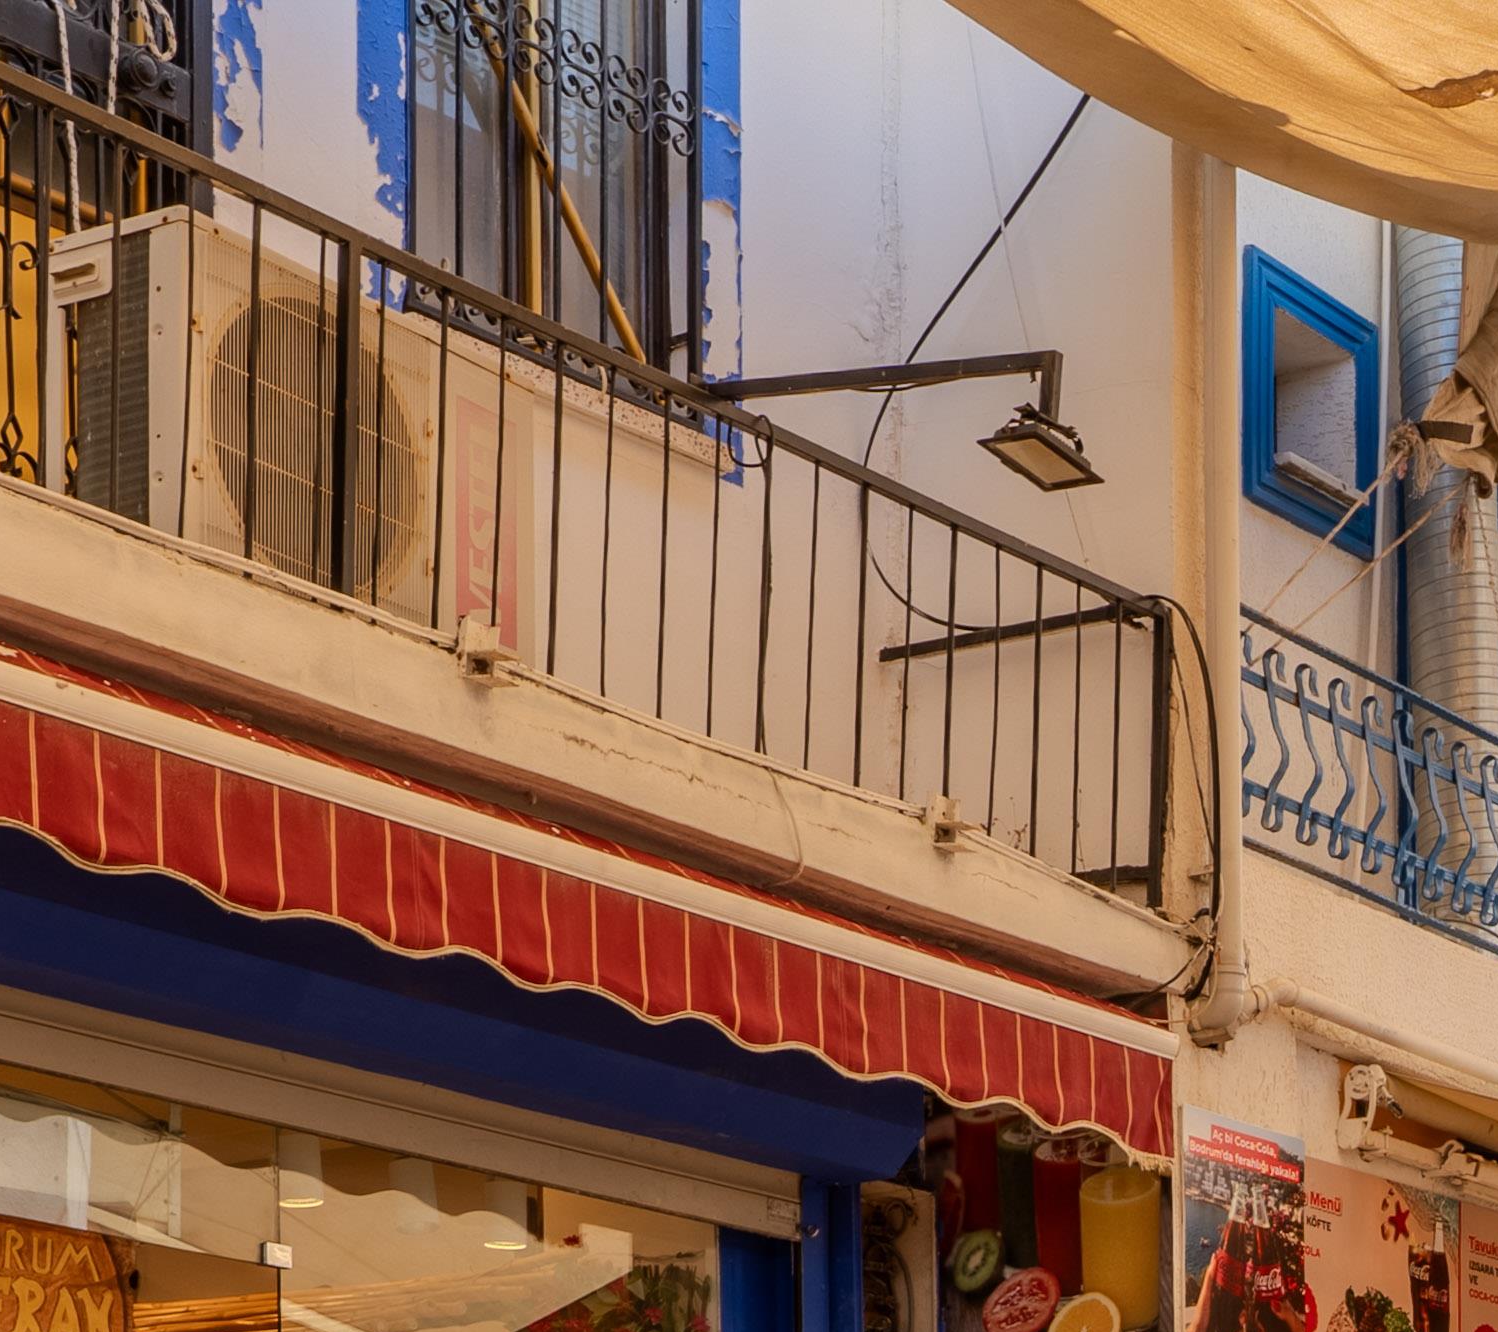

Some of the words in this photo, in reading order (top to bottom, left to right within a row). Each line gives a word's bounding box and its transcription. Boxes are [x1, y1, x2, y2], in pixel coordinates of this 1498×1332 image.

[1212, 1129, 1223, 1143] Aç
[1225, 1132, 1234, 1143] bi
[1189, 1140, 1234, 1162] Bodrum'da
[1270, 1162, 1299, 1181] yakala!
[1306, 1215, 1333, 1232] KÖFTE
[1468, 1273, 1479, 1285] VE
